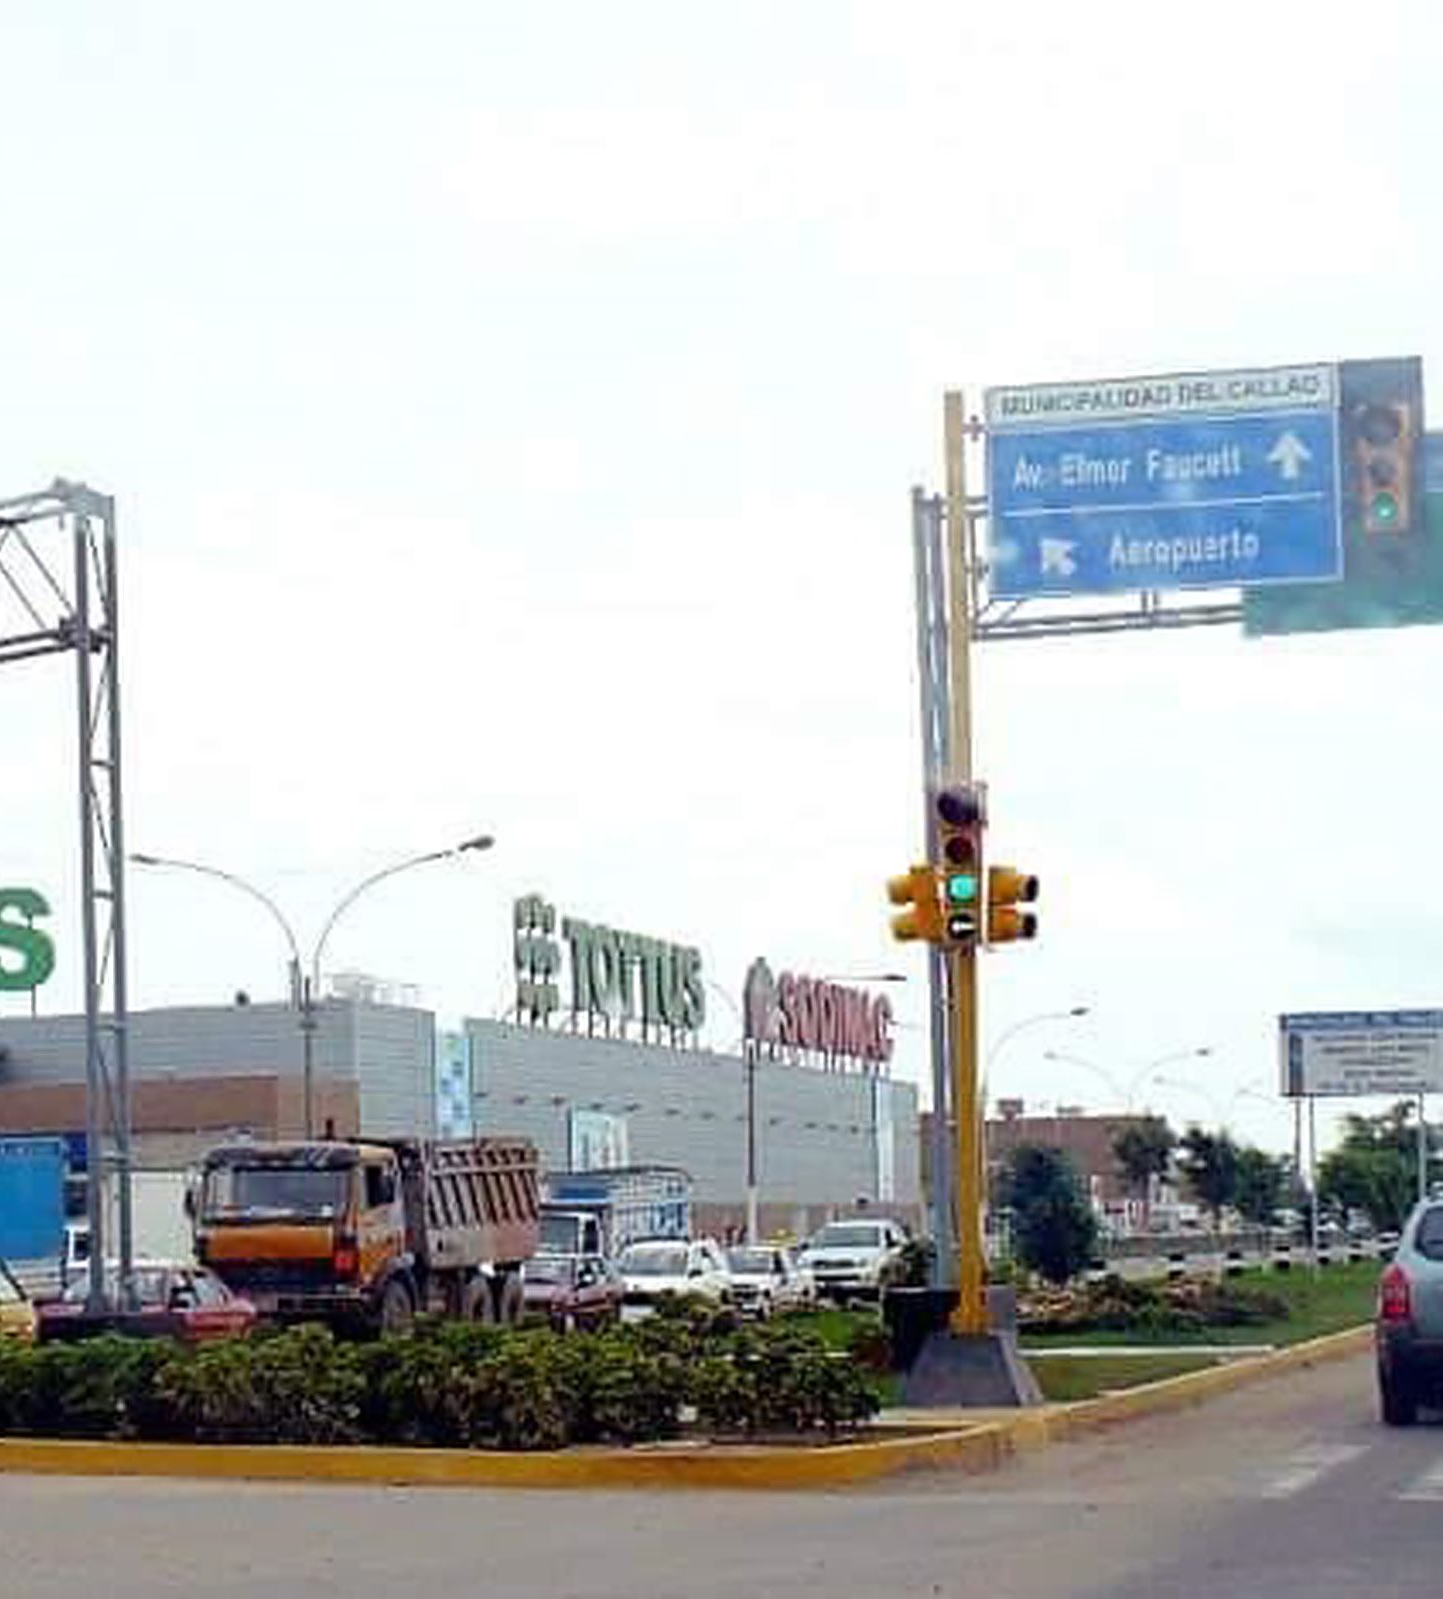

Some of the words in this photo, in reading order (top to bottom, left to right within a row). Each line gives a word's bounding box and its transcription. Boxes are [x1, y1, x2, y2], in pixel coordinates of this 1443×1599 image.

[1002, 384, 1171, 416] MUNICIPALIDAD
[1178, 381, 1220, 405] DEL
[1227, 373, 1320, 401] CALLAO
[1146, 442, 1242, 482] Faucett
[1107, 528, 1260, 575] Aeropuerto
[561, 915, 705, 1031] TOTTUS
[776, 970, 894, 1062] SODIMAC
